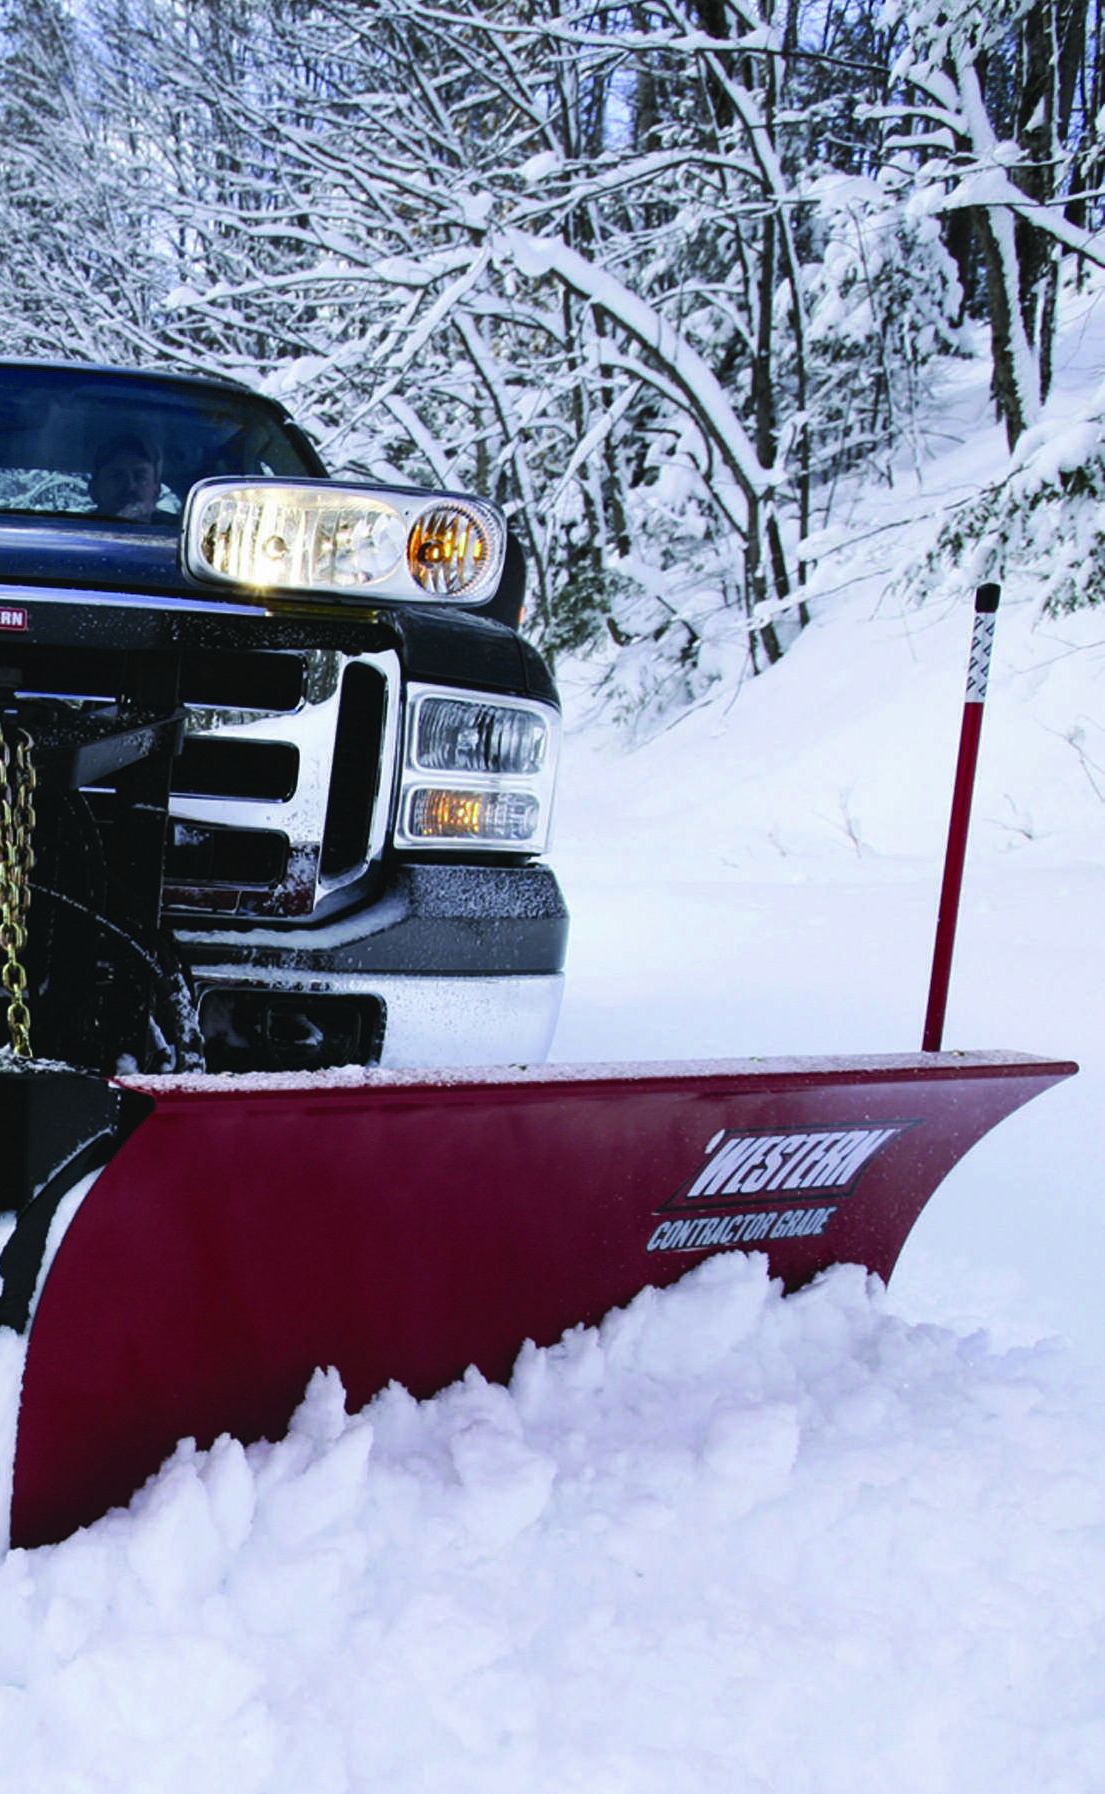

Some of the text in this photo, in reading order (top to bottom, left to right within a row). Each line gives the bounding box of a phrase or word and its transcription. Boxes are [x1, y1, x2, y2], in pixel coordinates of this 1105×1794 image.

[686, 1128, 901, 1197] WESTERN
[647, 1206, 837, 1251] CONTRACTOR GRADE
